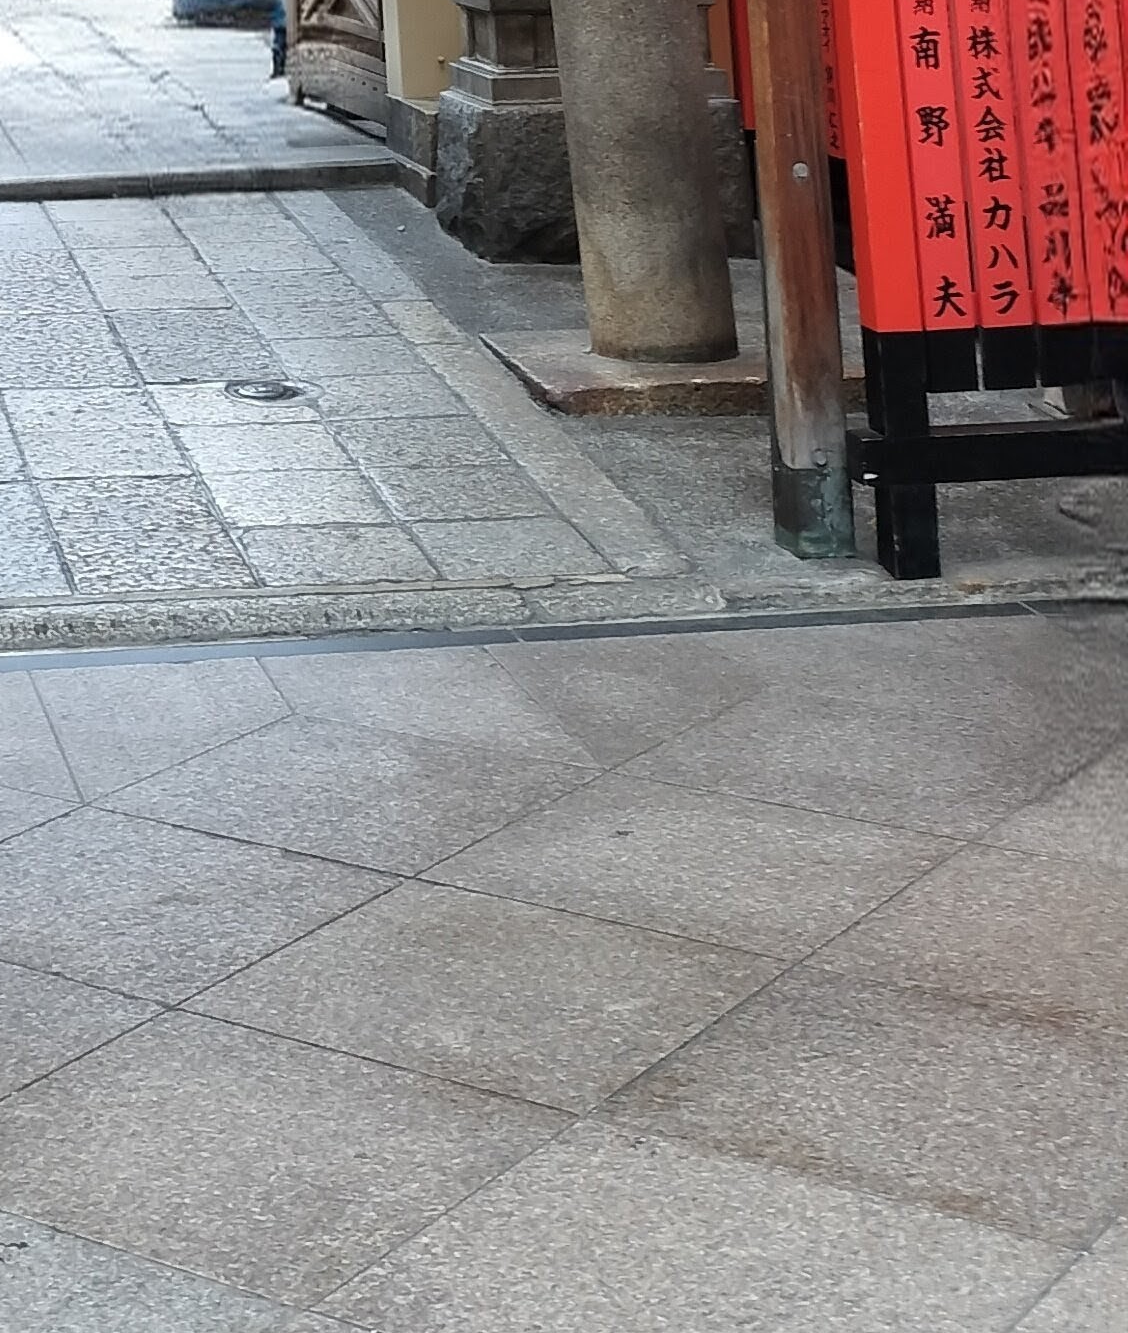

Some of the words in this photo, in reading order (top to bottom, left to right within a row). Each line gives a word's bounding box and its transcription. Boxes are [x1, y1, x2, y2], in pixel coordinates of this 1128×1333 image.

[967, 26, 1021, 315] 株式会社カハラ
